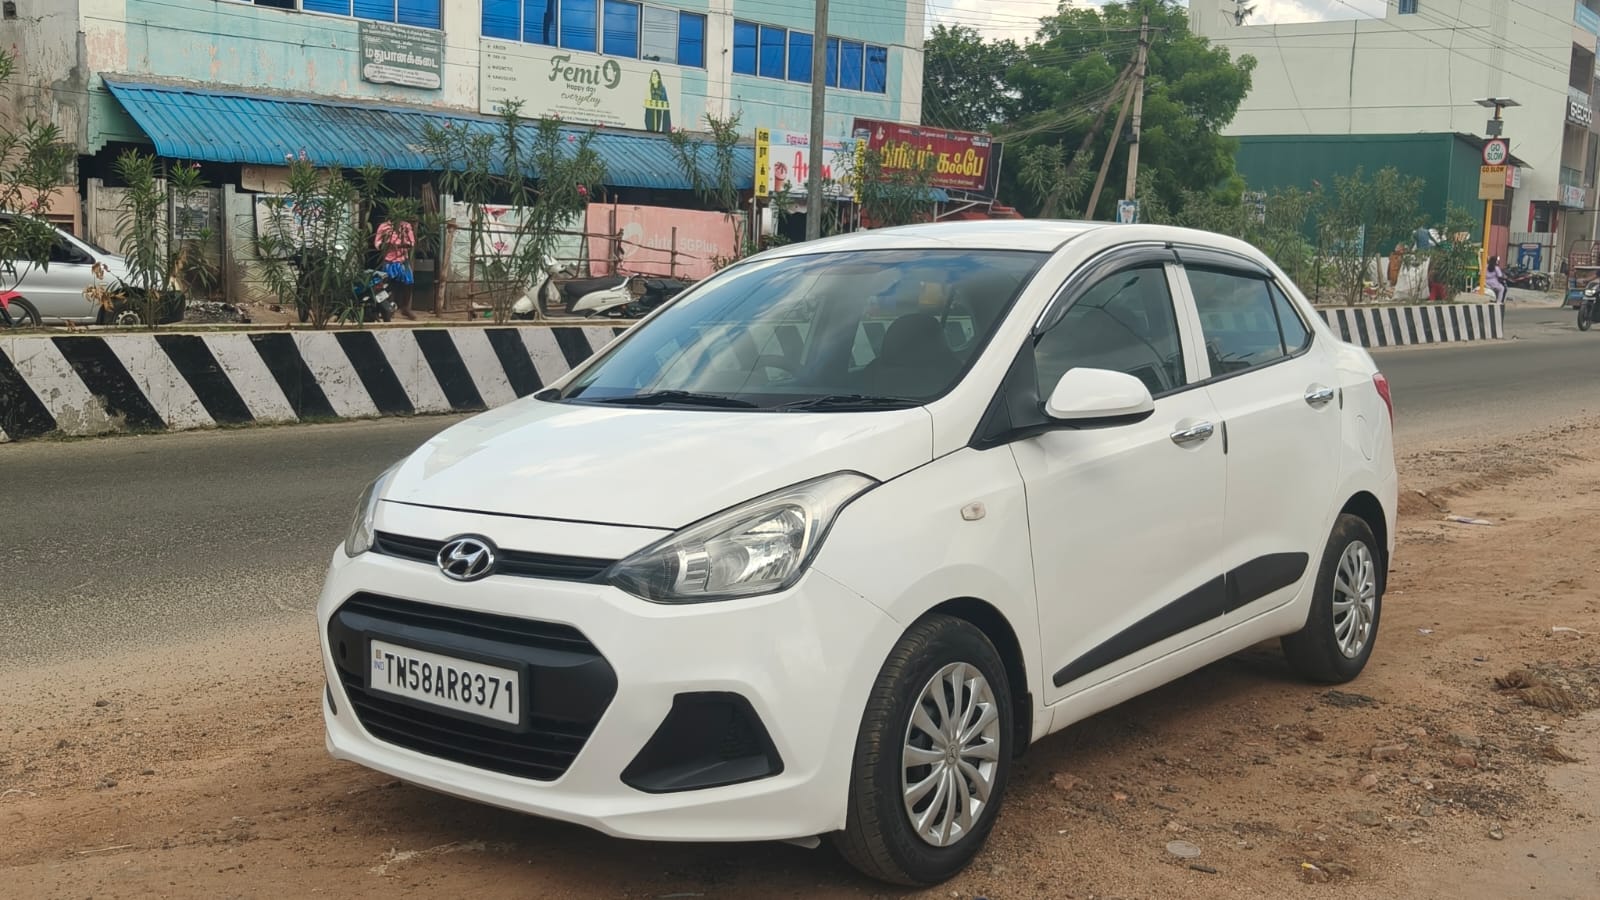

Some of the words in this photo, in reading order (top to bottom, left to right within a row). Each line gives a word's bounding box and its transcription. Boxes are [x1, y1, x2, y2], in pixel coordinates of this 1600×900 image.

[365, 48, 439, 69] மதுபானக்கடை
[566, 83, 585, 93] Happy
[560, 92, 601, 107] everyday
[1490, 143, 1501, 152] GO
[936, 147, 985, 177] கஃபே
[1487, 152, 1504, 161] SLOW
[1490, 166, 1505, 174] SLOW
[384, 652, 514, 714] TN58AR8371
